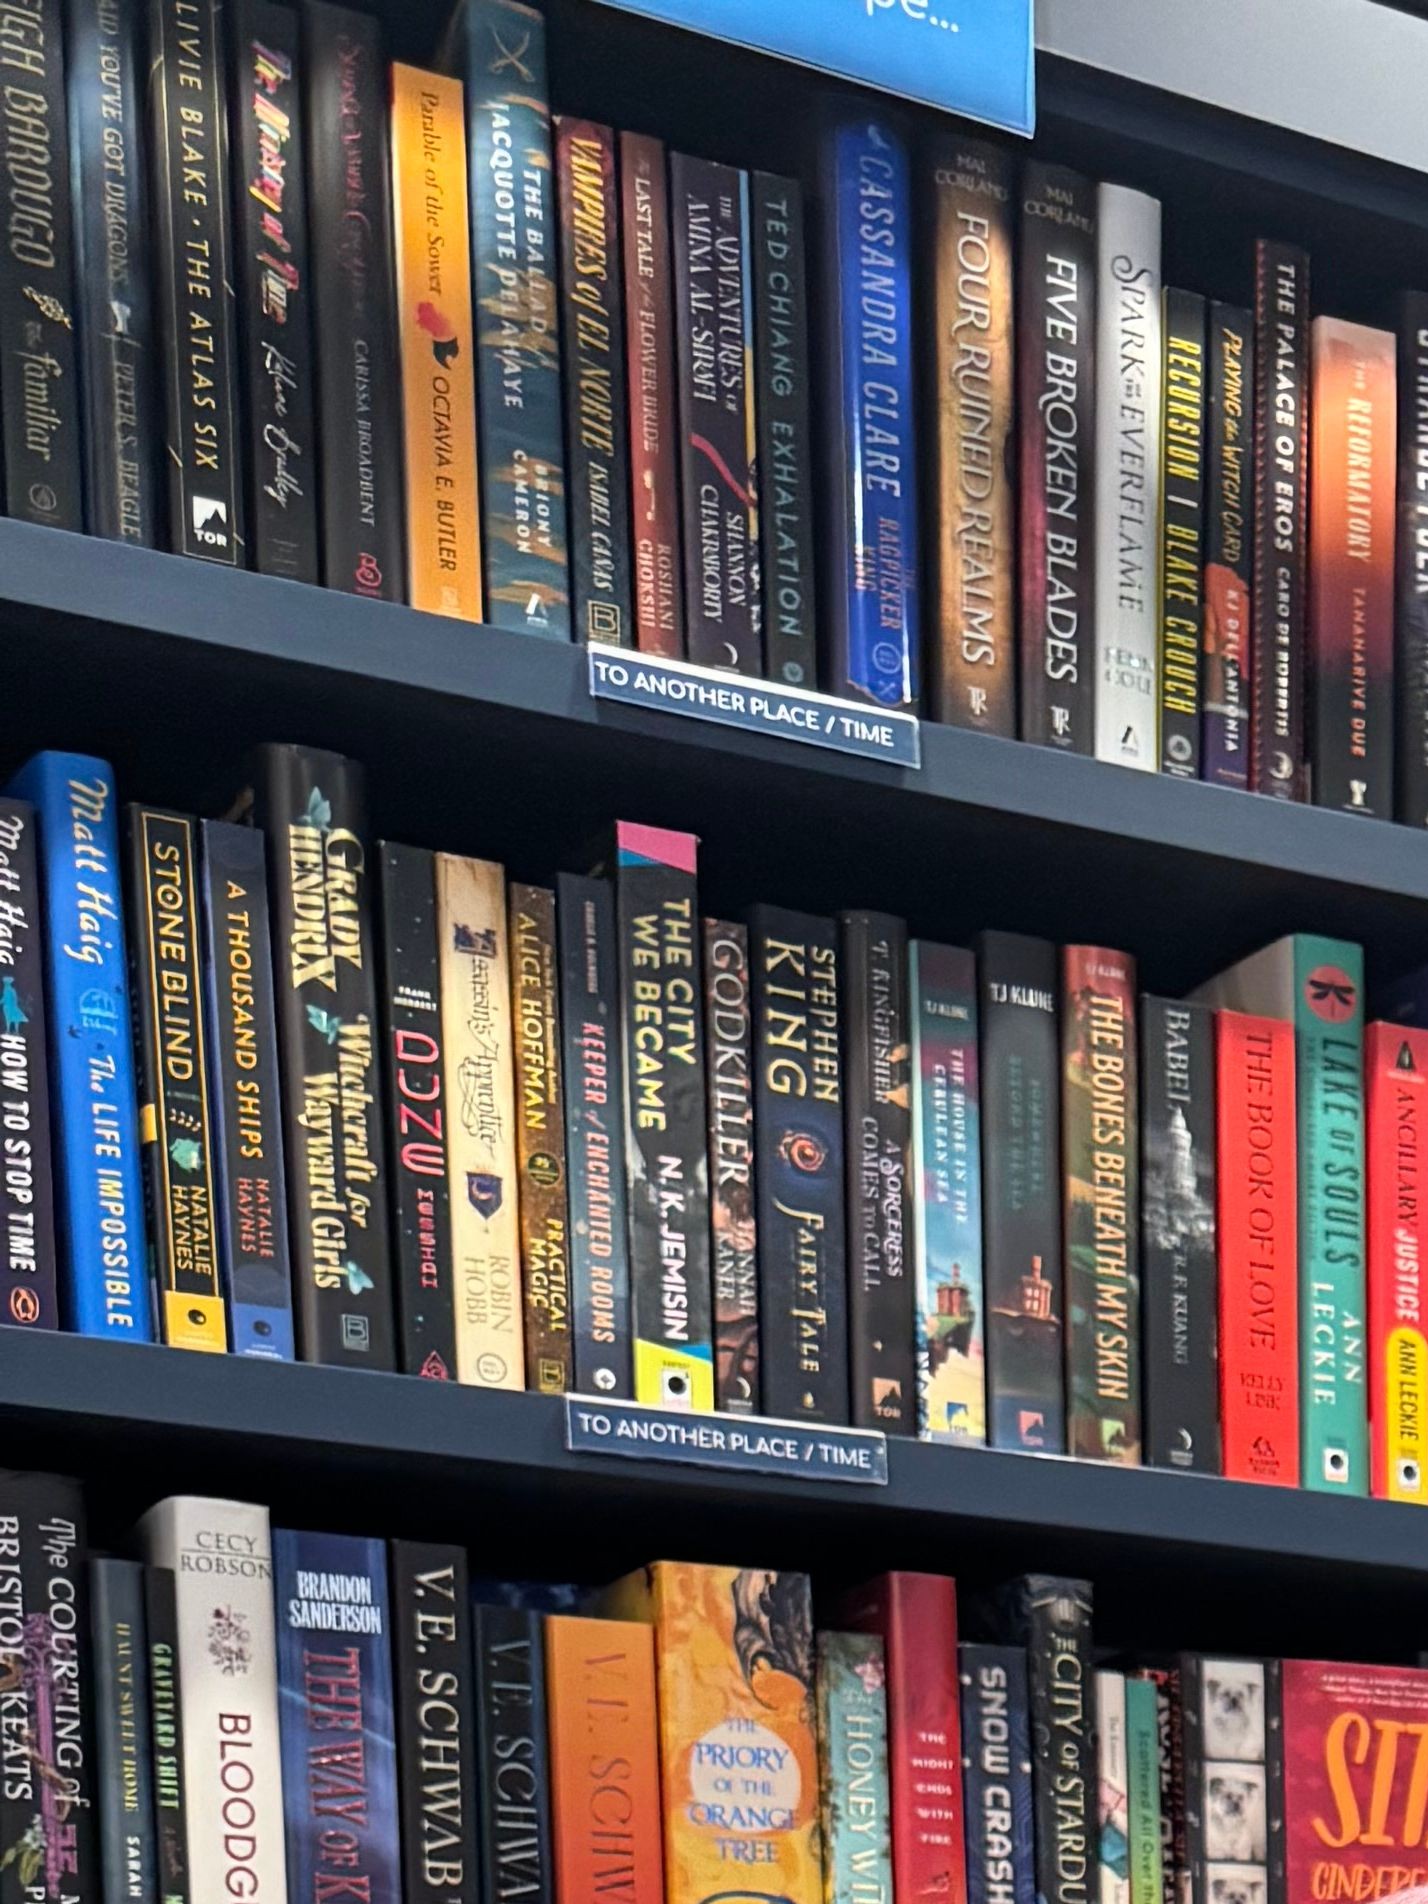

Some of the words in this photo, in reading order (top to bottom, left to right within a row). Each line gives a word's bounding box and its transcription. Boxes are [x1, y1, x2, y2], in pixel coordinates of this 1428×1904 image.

[4, 89, 56, 269] BARDUGO
[180, 106, 208, 207] BLAKE
[186, 239, 211, 300] THE
[856, 153, 900, 366] CASSANDRA
[1045, 253, 1078, 336] FIVE
[189, 311, 216, 411] ATLAS
[195, 423, 219, 470] SIX
[432, 374, 454, 467] OCTAVIA
[862, 376, 903, 499] CLARE
[1042, 345, 1080, 520] BROKEN
[435, 499, 458, 571] BUTLER
[1045, 531, 1080, 686] BLADES
[595, 661, 628, 686] TO
[634, 671, 745, 712] ANOTHER
[750, 695, 820, 730] PLACE
[839, 717, 894, 747] TIME
[68, 778, 112, 878] Matt
[62, 886, 118, 966] Haig
[152, 841, 186, 967] STONE
[631, 914, 660, 970] WE
[664, 899, 692, 968] THE
[158, 970, 192, 1082] BLIND
[225, 910, 259, 1072] THOUSAND
[664, 975, 696, 1068] CITY
[762, 939, 807, 1097] KING
[1090, 995, 1125, 1040] THE
[1, 1032, 30, 1095] HOW
[632, 980, 666, 1132] BECAME
[1090, 1045, 1126, 1140] BONES
[1243, 1032, 1275, 1088] THE
[2, 1100, 30, 1132] TO
[90, 1101, 121, 1162] LIFE
[236, 1079, 264, 1161] SHIPS
[1244, 1098, 1276, 1196] BOOK
[4, 1138, 31, 1202] STOP
[1094, 1149, 1127, 1275] BENEATH
[8, 1206, 36, 1274] TIME
[95, 1170, 134, 1329] IMPOSSIBLE
[1248, 1204, 1276, 1250] OF
[660, 1222, 690, 1342] JEMISIN
[1096, 1279, 1128, 1327] MY
[1248, 1260, 1277, 1352] LOVE
[1096, 1332, 1130, 1401] SKIN
[578, 1412, 610, 1435] TO
[616, 1419, 725, 1450] ANOTHER
[730, 1432, 799, 1459] PLACE
[818, 1443, 871, 1468] TIME
[180, 1554, 272, 1581] ROBSON
[195, 1530, 258, 1554] CECY
[289, 1601, 382, 1635] SANDERSON
[296, 1570, 372, 1605] BRANDON
[1, 1689, 34, 1803] KEATS
[980, 1668, 1011, 1777] SNOW
[415, 1669, 465, 1889] SCHWAB
